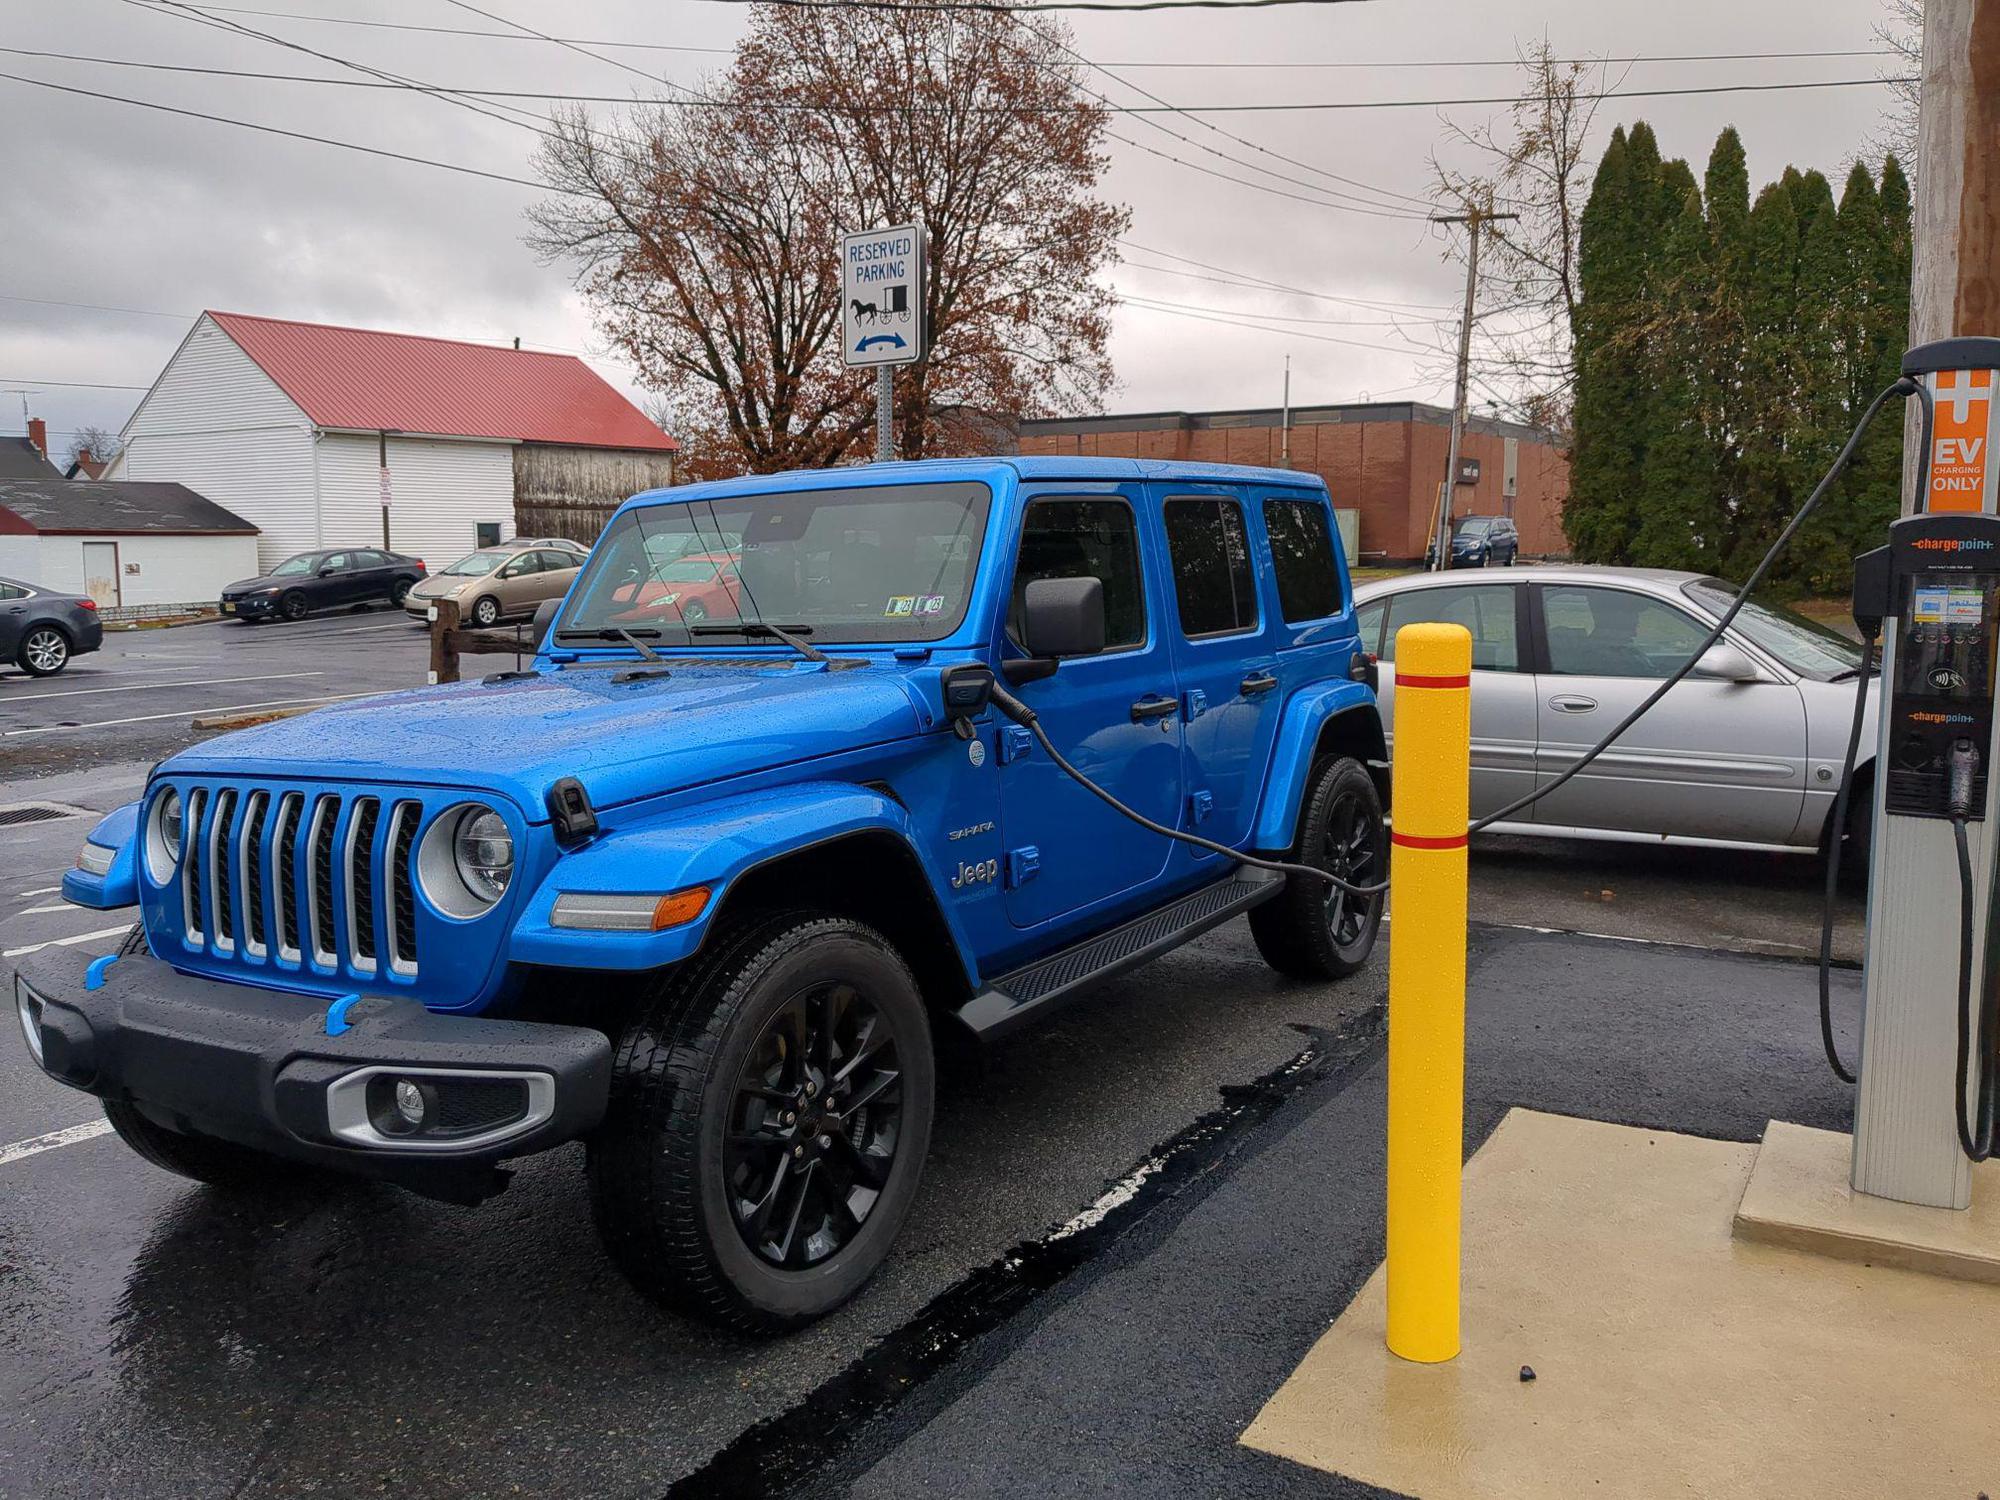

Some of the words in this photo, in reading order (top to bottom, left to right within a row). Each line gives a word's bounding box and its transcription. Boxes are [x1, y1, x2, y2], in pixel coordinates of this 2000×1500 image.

[850, 238, 911, 262] RESERVED
[856, 260, 905, 283] PARKING
[1935, 438, 1983, 464] EV
[1933, 466, 1981, 474] CHARGING
[1932, 476, 1981, 491] ONLY
[949, 821, 996, 840] SAHARA
[951, 859, 998, 888] Jeep
